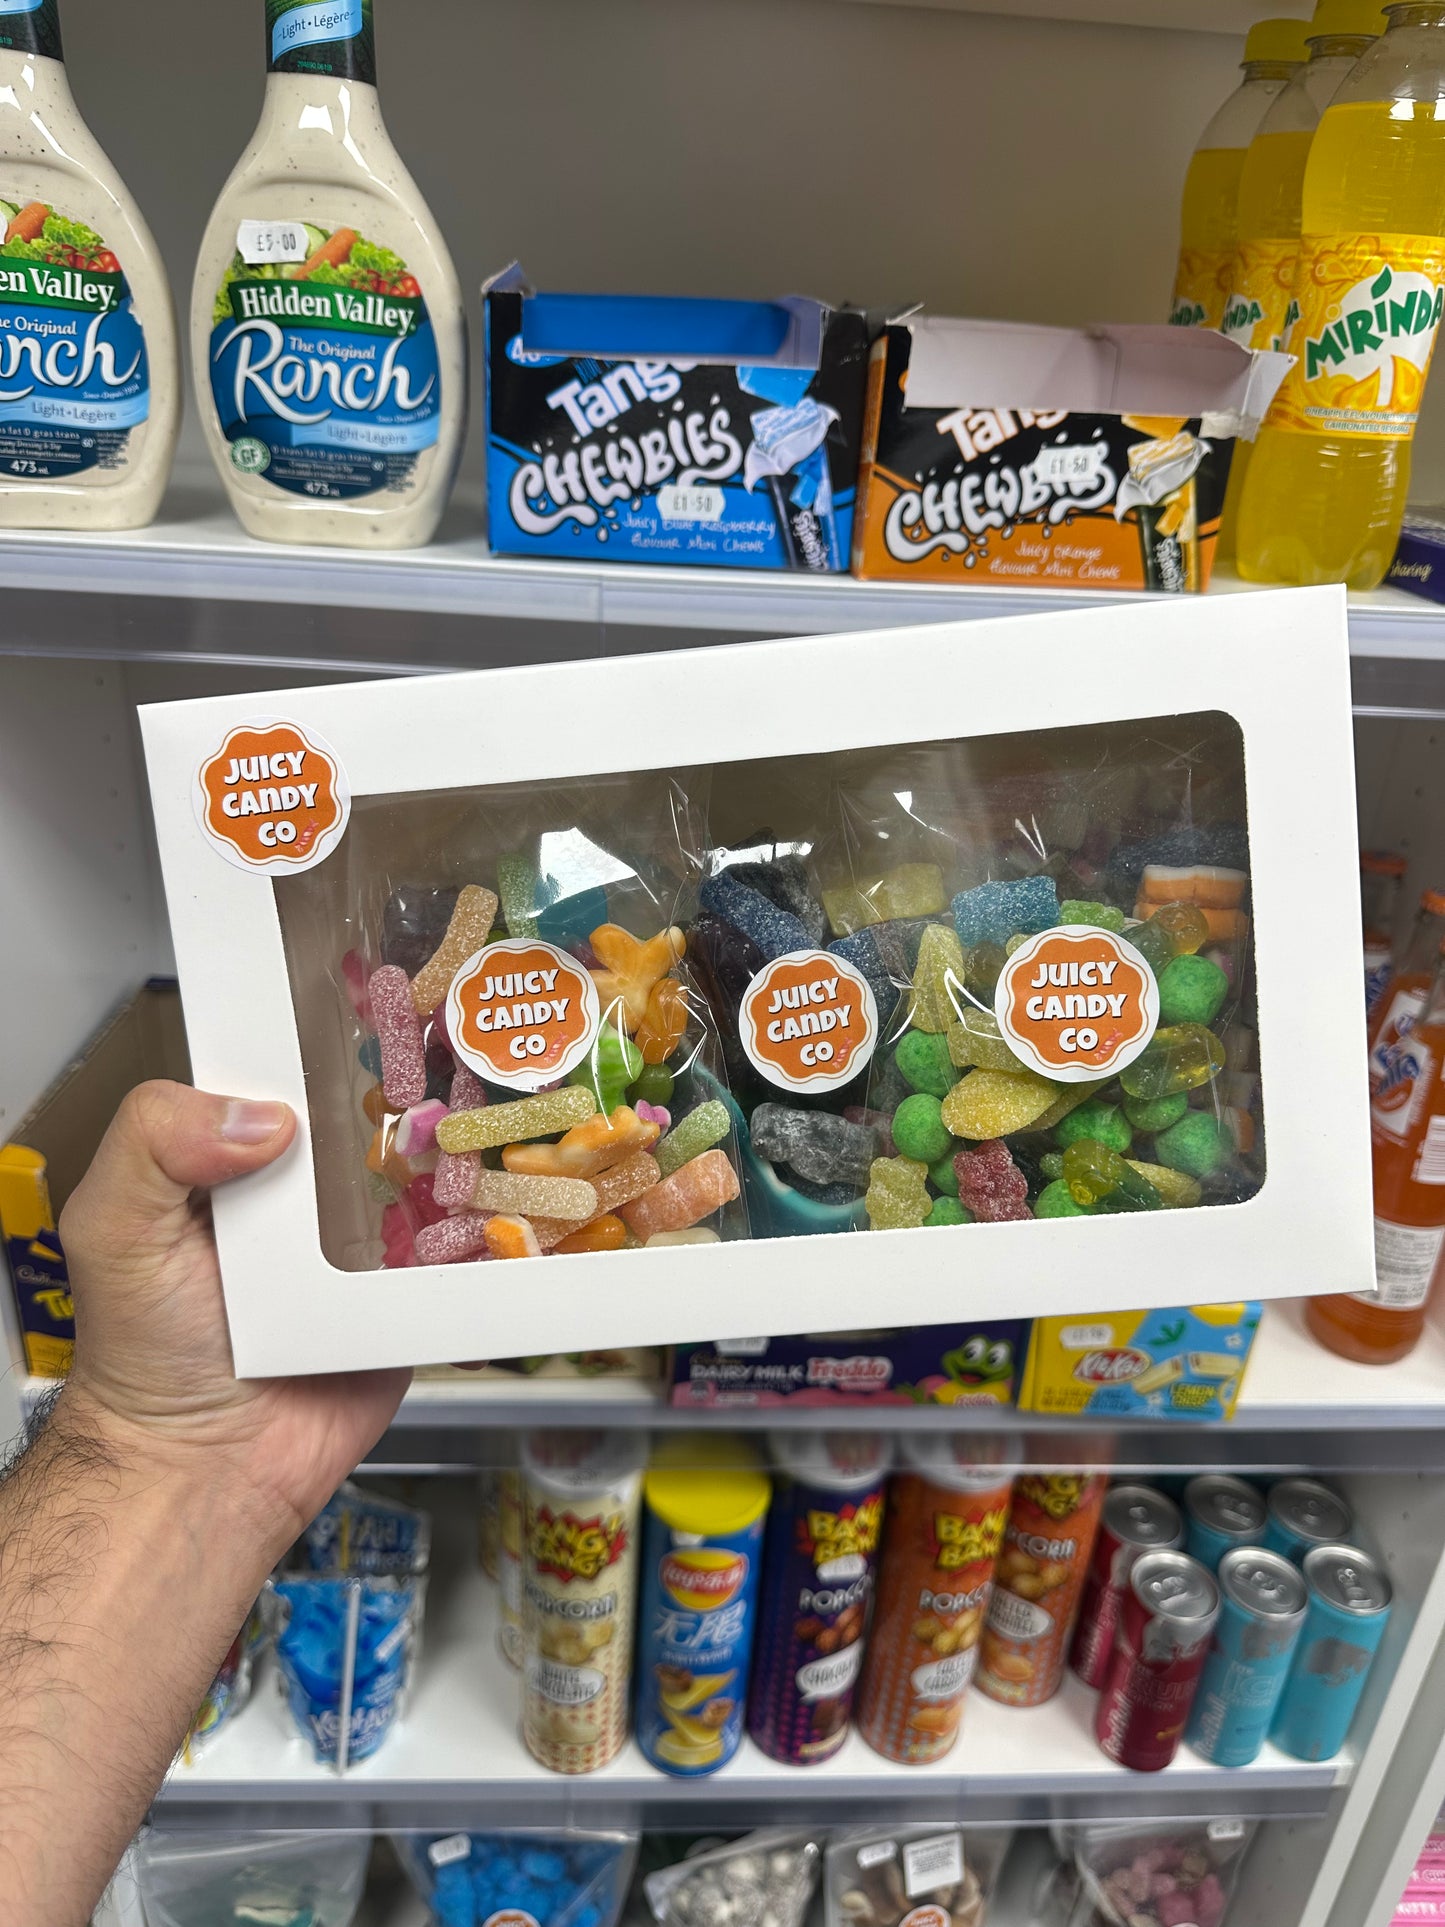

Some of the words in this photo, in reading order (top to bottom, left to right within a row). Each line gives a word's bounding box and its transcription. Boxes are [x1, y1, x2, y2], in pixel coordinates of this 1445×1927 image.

[282, 19, 306, 40] Light
[314, 11, 350, 29] Légère
[239, 286, 333, 320] Hidden
[14, 316, 78, 337] Original
[288, 335, 316, 354] The
[316, 340, 376, 361] Original
[214, 319, 436, 425] Ranch
[32, 402, 66, 418] Light
[73, 407, 117, 423] Légère
[546, 358, 699, 438] Tang
[327, 424, 359, 441] Light
[10, 460, 38, 473] 473
[510, 407, 743, 535] CHEWBIES
[223, 751, 307, 785] JUICY
[221, 783, 319, 818] CANDY
[257, 821, 297, 848] CO
[478, 968, 559, 1001] JUICY
[1031, 960, 1118, 989] JUICY
[767, 976, 840, 1013] JUICY
[1026, 993, 1128, 1021] CANDY
[475, 998, 569, 1033] CANDY
[766, 1005, 851, 1043] CANDY
[509, 1034, 546, 1059] CO
[800, 1041, 834, 1067] CO
[1058, 1027, 1099, 1052] CO
